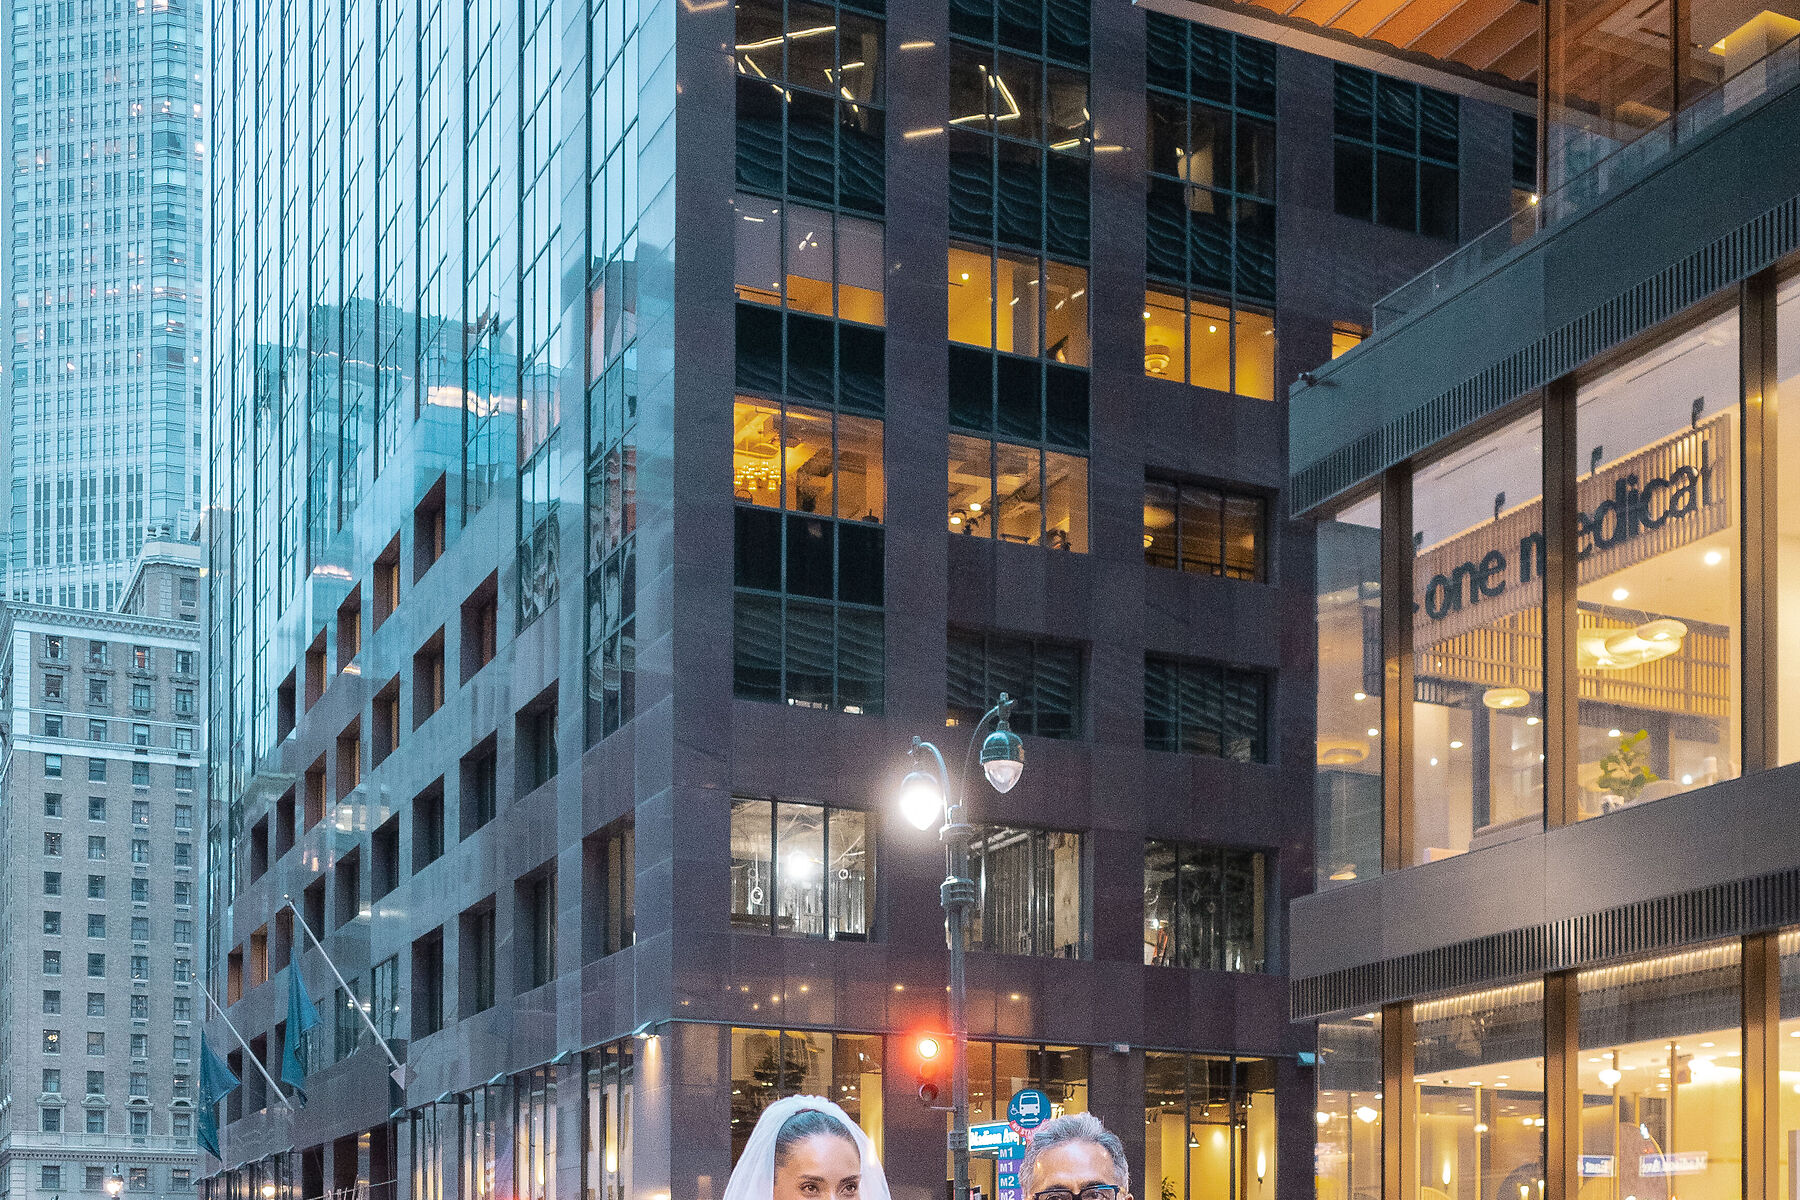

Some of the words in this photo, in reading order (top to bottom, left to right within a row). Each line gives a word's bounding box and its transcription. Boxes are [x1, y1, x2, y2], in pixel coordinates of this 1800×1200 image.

[1425, 549, 1506, 620] one
[1000, 1147, 1013, 1158] M1
[1000, 1162, 1013, 1172] M1
[1000, 1177, 1014, 1187] M2
